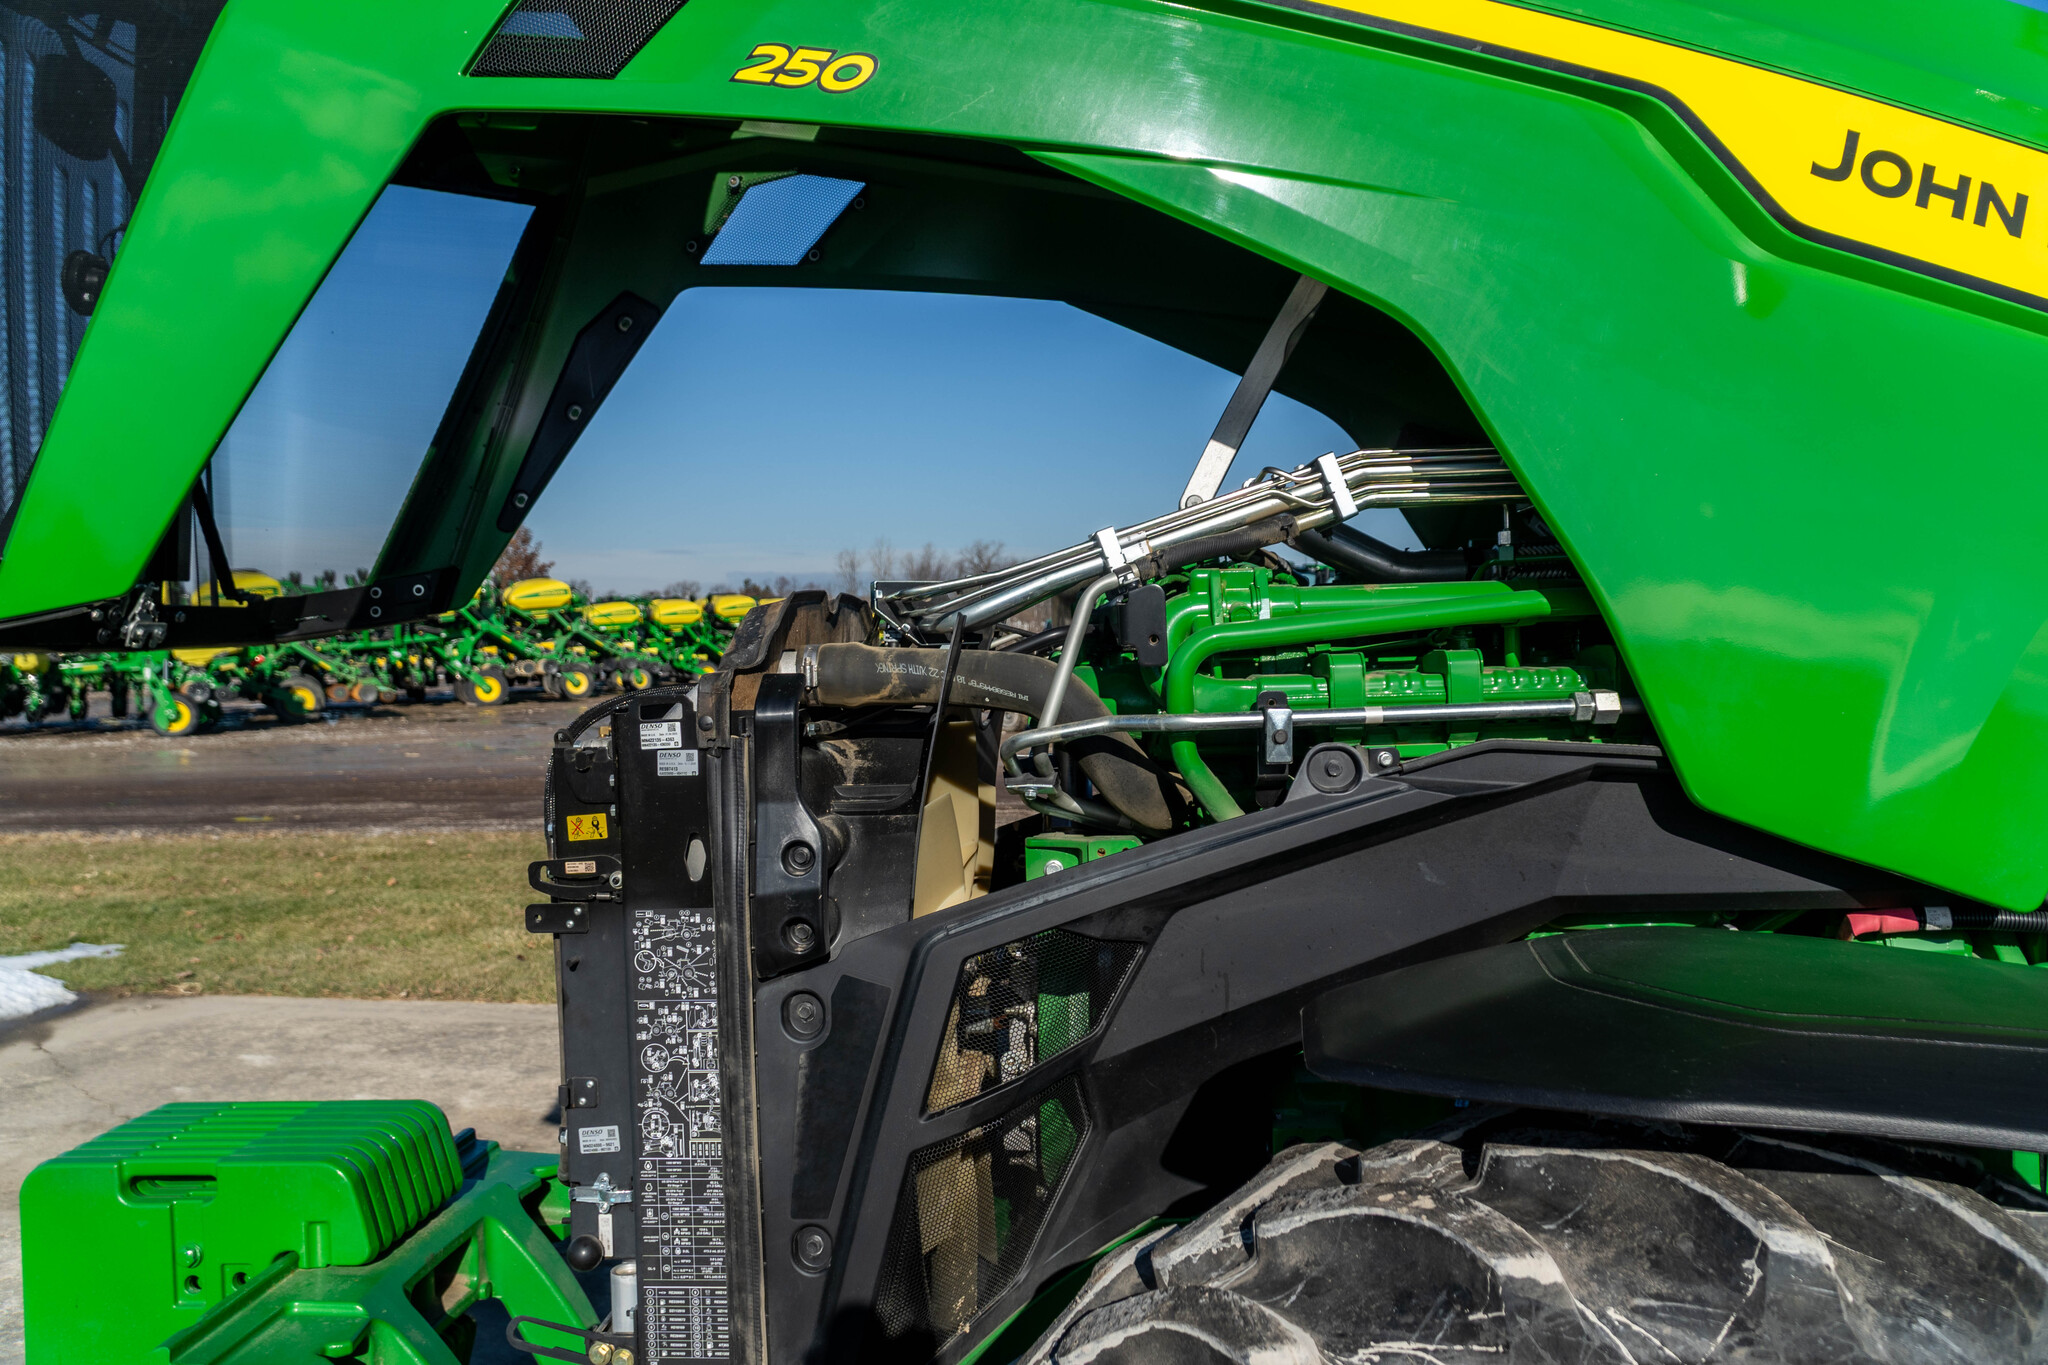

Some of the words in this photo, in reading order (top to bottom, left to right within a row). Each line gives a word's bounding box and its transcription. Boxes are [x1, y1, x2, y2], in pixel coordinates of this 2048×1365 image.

[729, 43, 879, 93] 250
[1810, 129, 2029, 239] JOHN
[928, 667, 940, 678] 22
